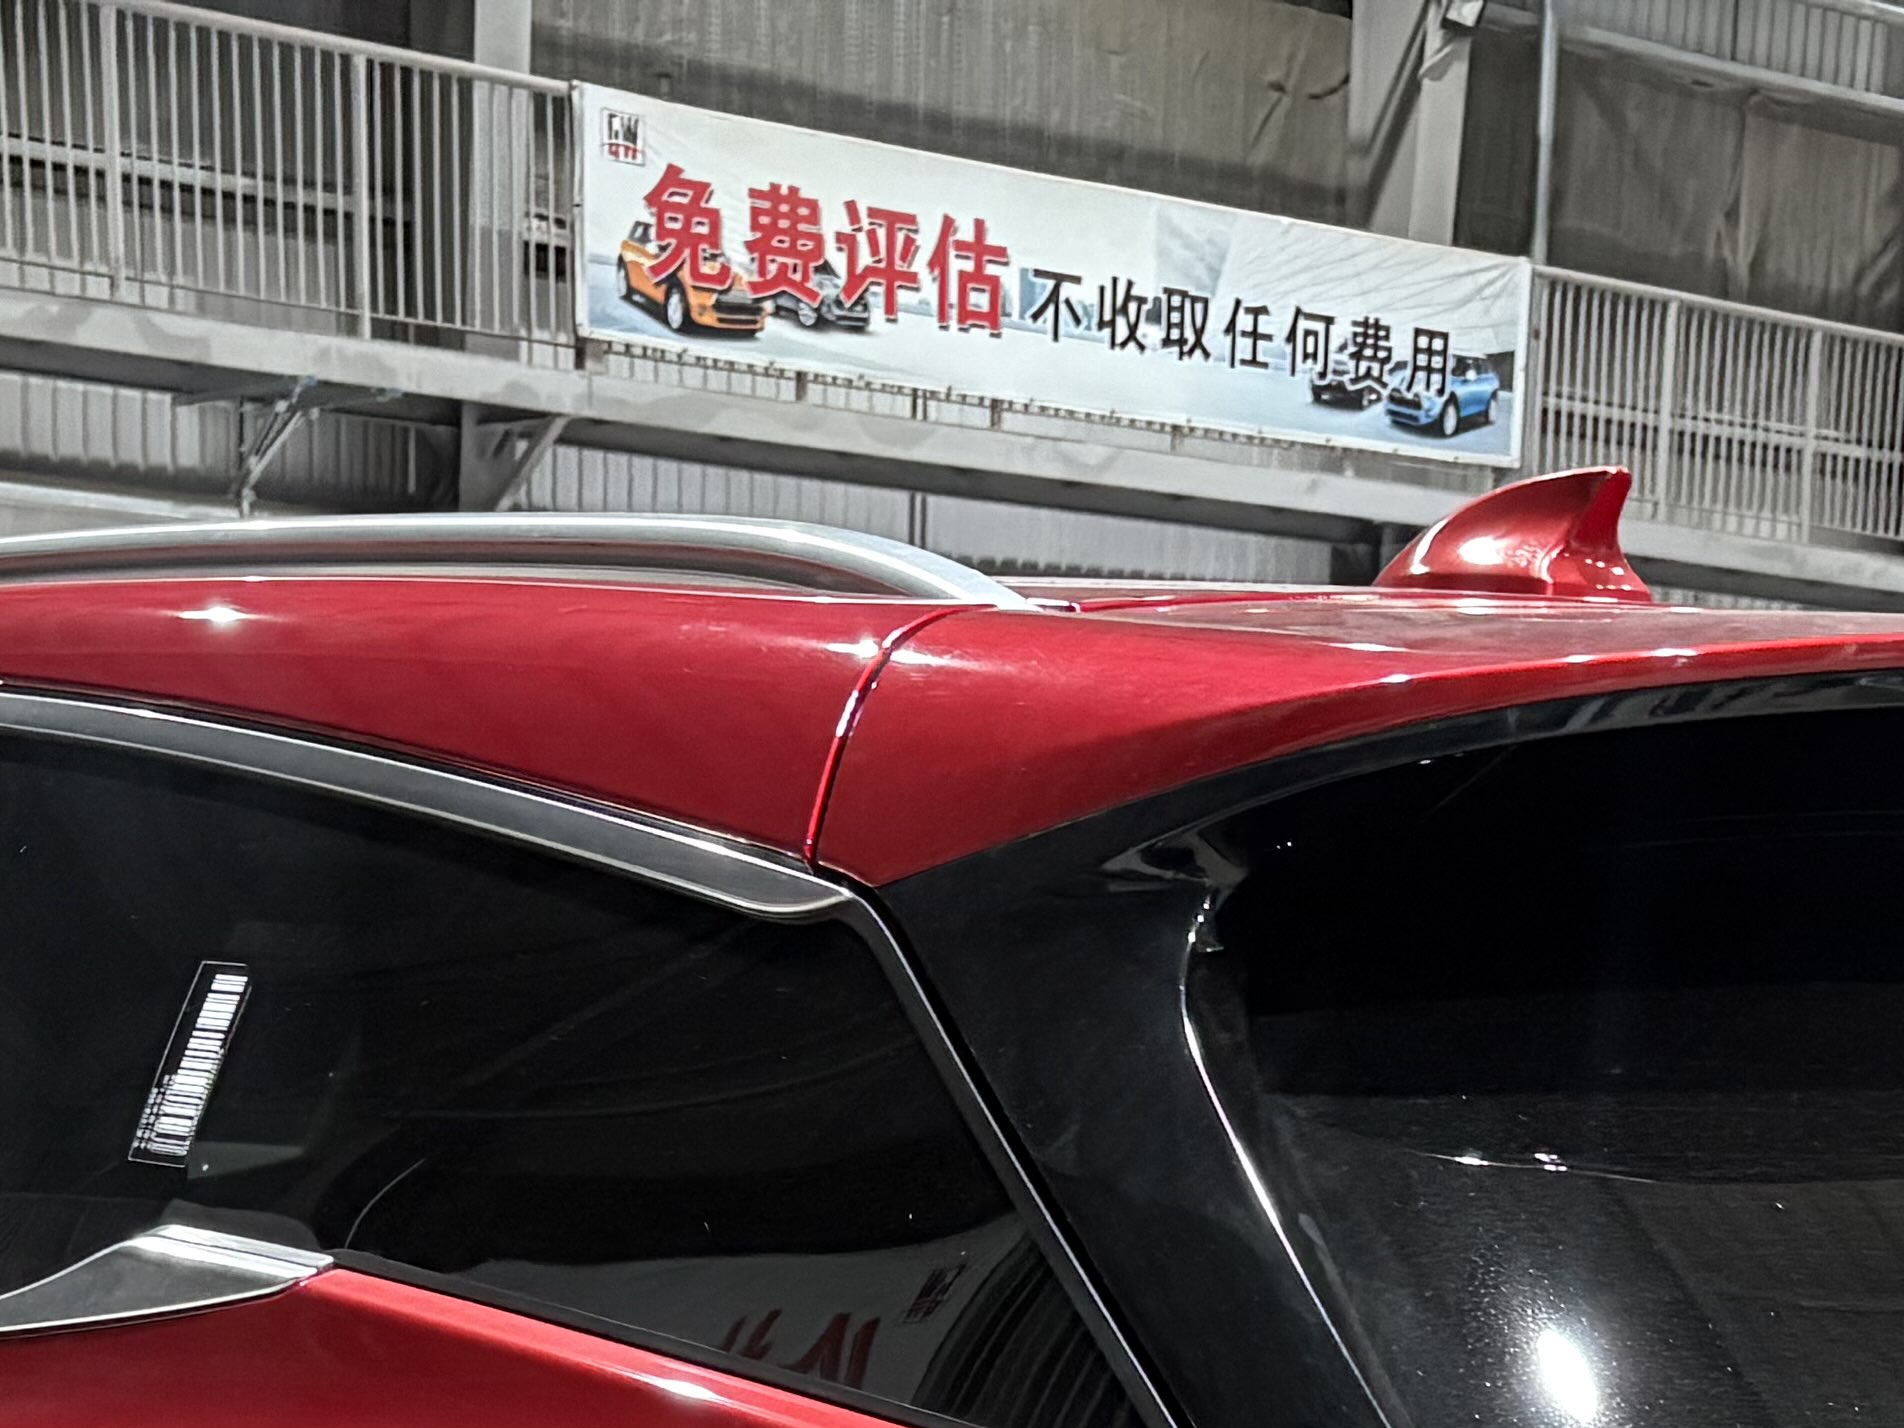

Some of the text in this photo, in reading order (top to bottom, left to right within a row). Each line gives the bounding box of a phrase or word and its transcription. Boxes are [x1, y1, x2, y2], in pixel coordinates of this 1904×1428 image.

[643, 162, 1452, 397] 免费评估 不收取任何费用
